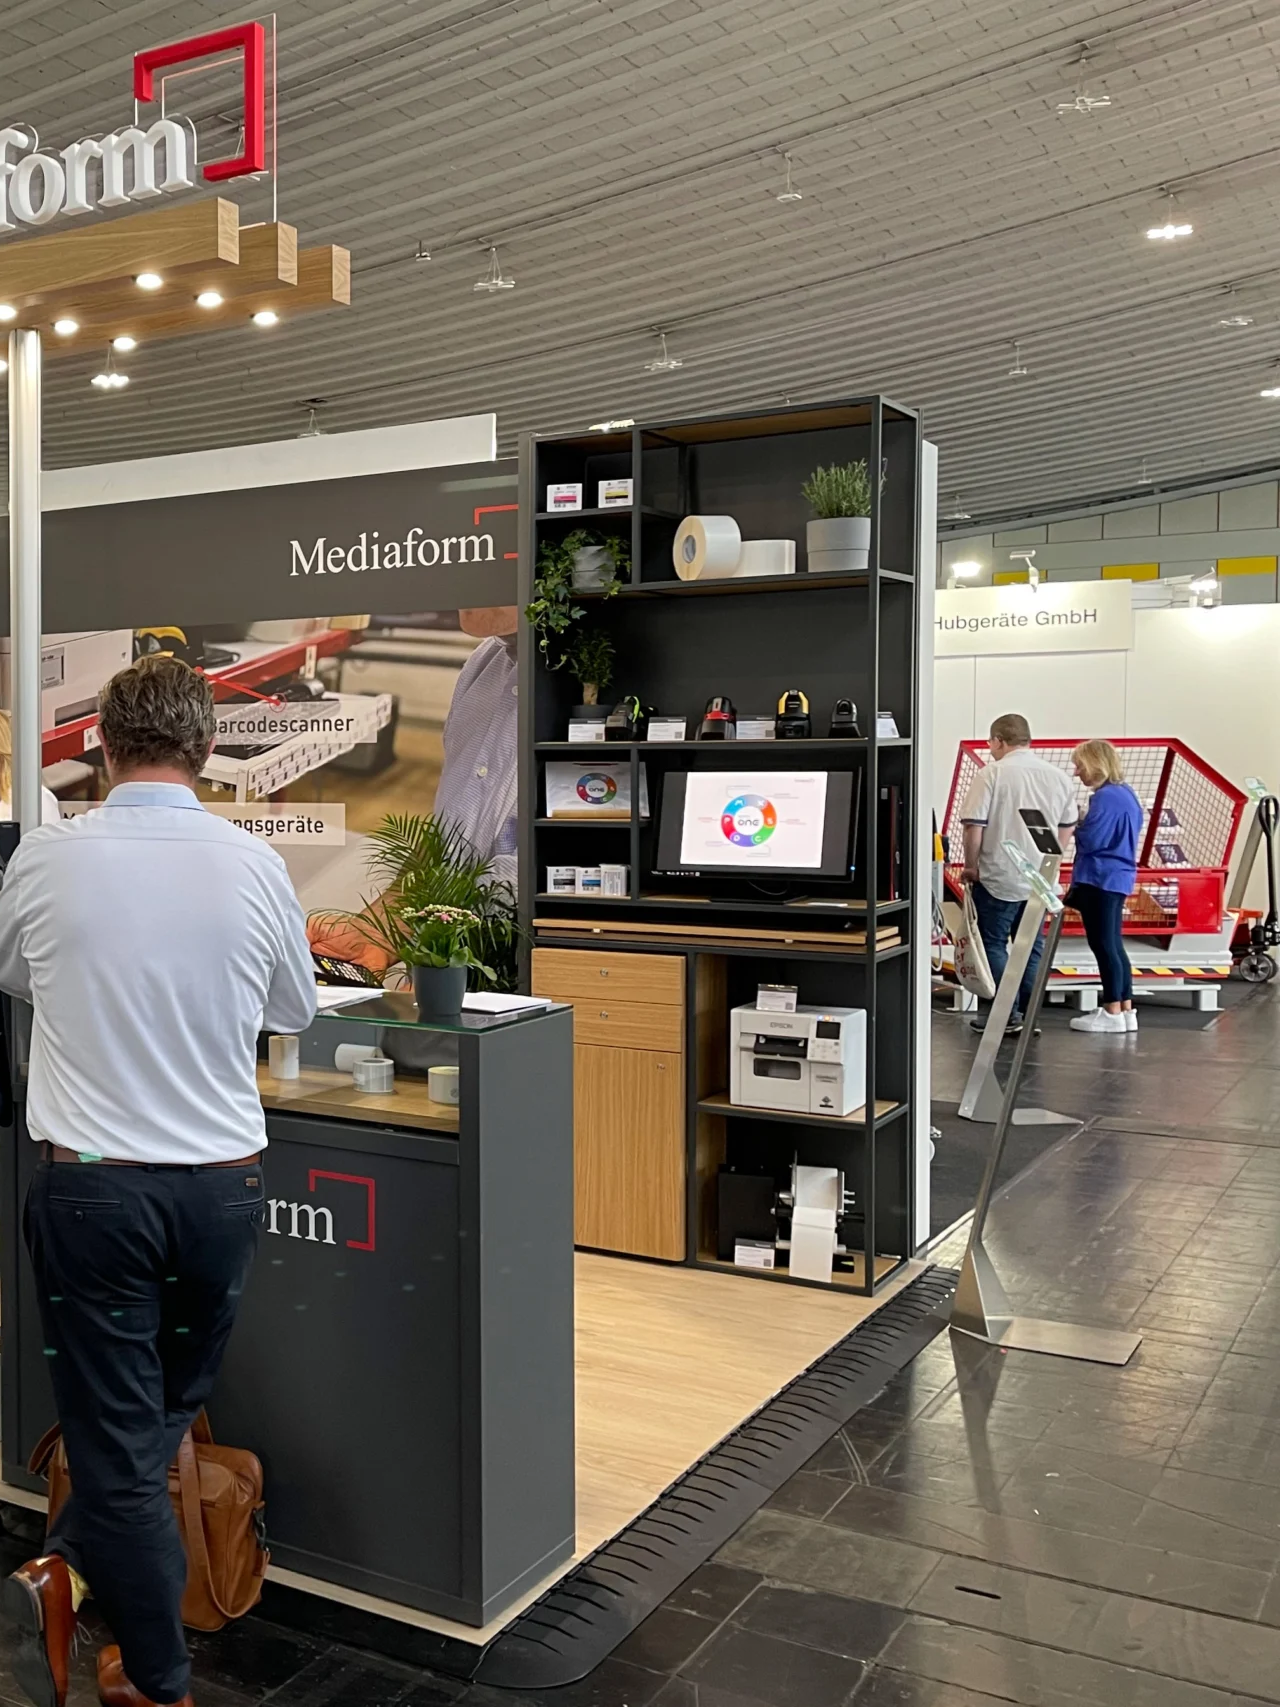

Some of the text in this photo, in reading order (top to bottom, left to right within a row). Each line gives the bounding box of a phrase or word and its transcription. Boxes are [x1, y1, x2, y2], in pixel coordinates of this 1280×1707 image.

[290, 527, 497, 577] Mediaform
[1035, 608, 1097, 626] GmbH
[770, 1021, 793, 1029] EPSON
